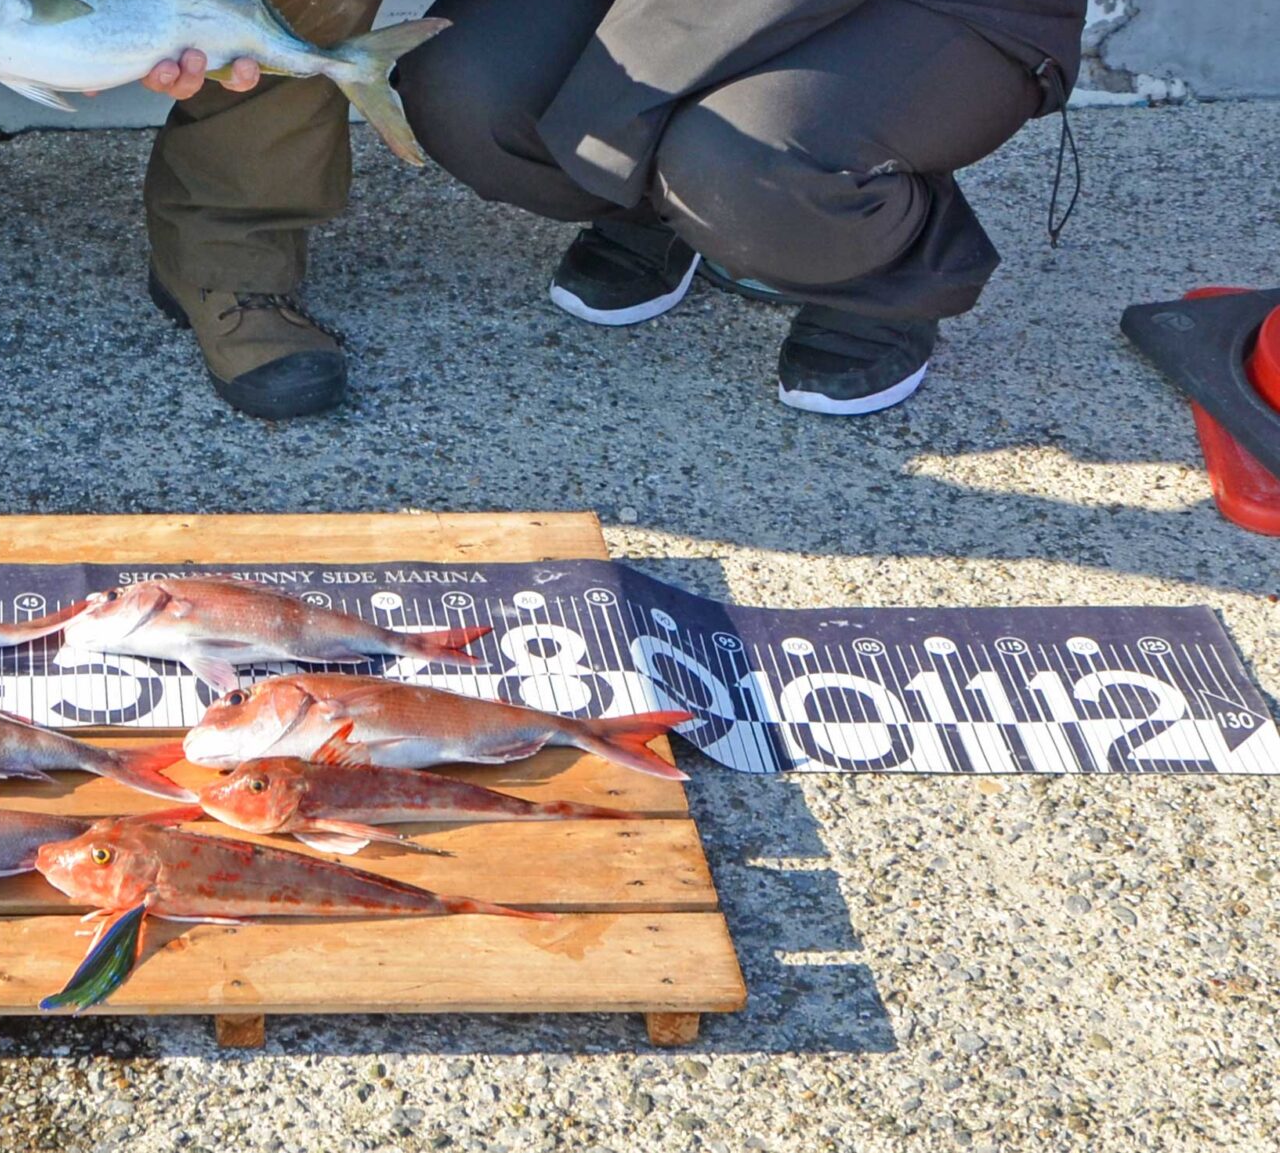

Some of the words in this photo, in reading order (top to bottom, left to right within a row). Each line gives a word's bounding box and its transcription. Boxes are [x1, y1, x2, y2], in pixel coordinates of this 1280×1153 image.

[322, 571, 377, 584] SIDE
[384, 570, 488, 584] MARINA
[856, 642, 880, 653] 105
[999, 641, 1022, 651] 115
[1142, 640, 1166, 651] 125
[498, 623, 615, 720] 8
[1217, 712, 1255, 730] 130
